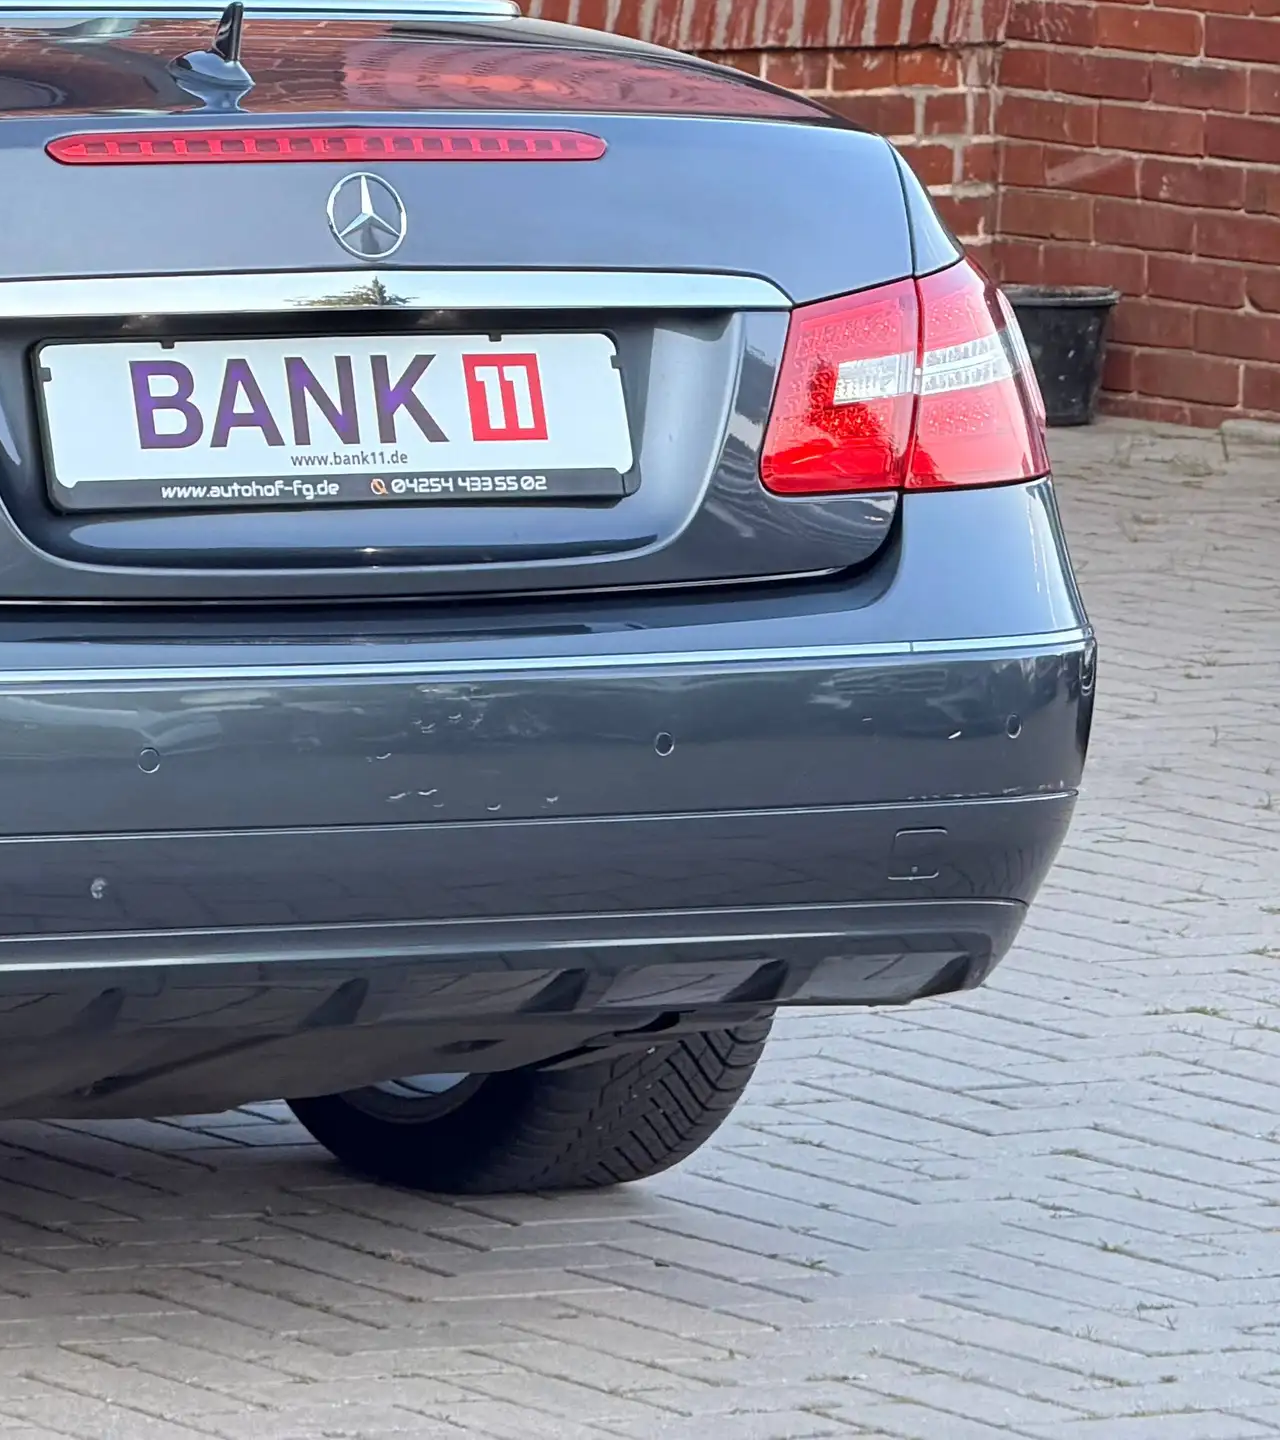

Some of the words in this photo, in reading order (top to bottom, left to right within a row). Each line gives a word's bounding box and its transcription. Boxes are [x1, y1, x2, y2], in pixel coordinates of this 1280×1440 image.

[129, 353, 450, 450] BANK
[475, 364, 536, 431] 11
[290, 450, 409, 468] www.bank11.de
[160, 479, 340, 501] www.autohof-fg.de
